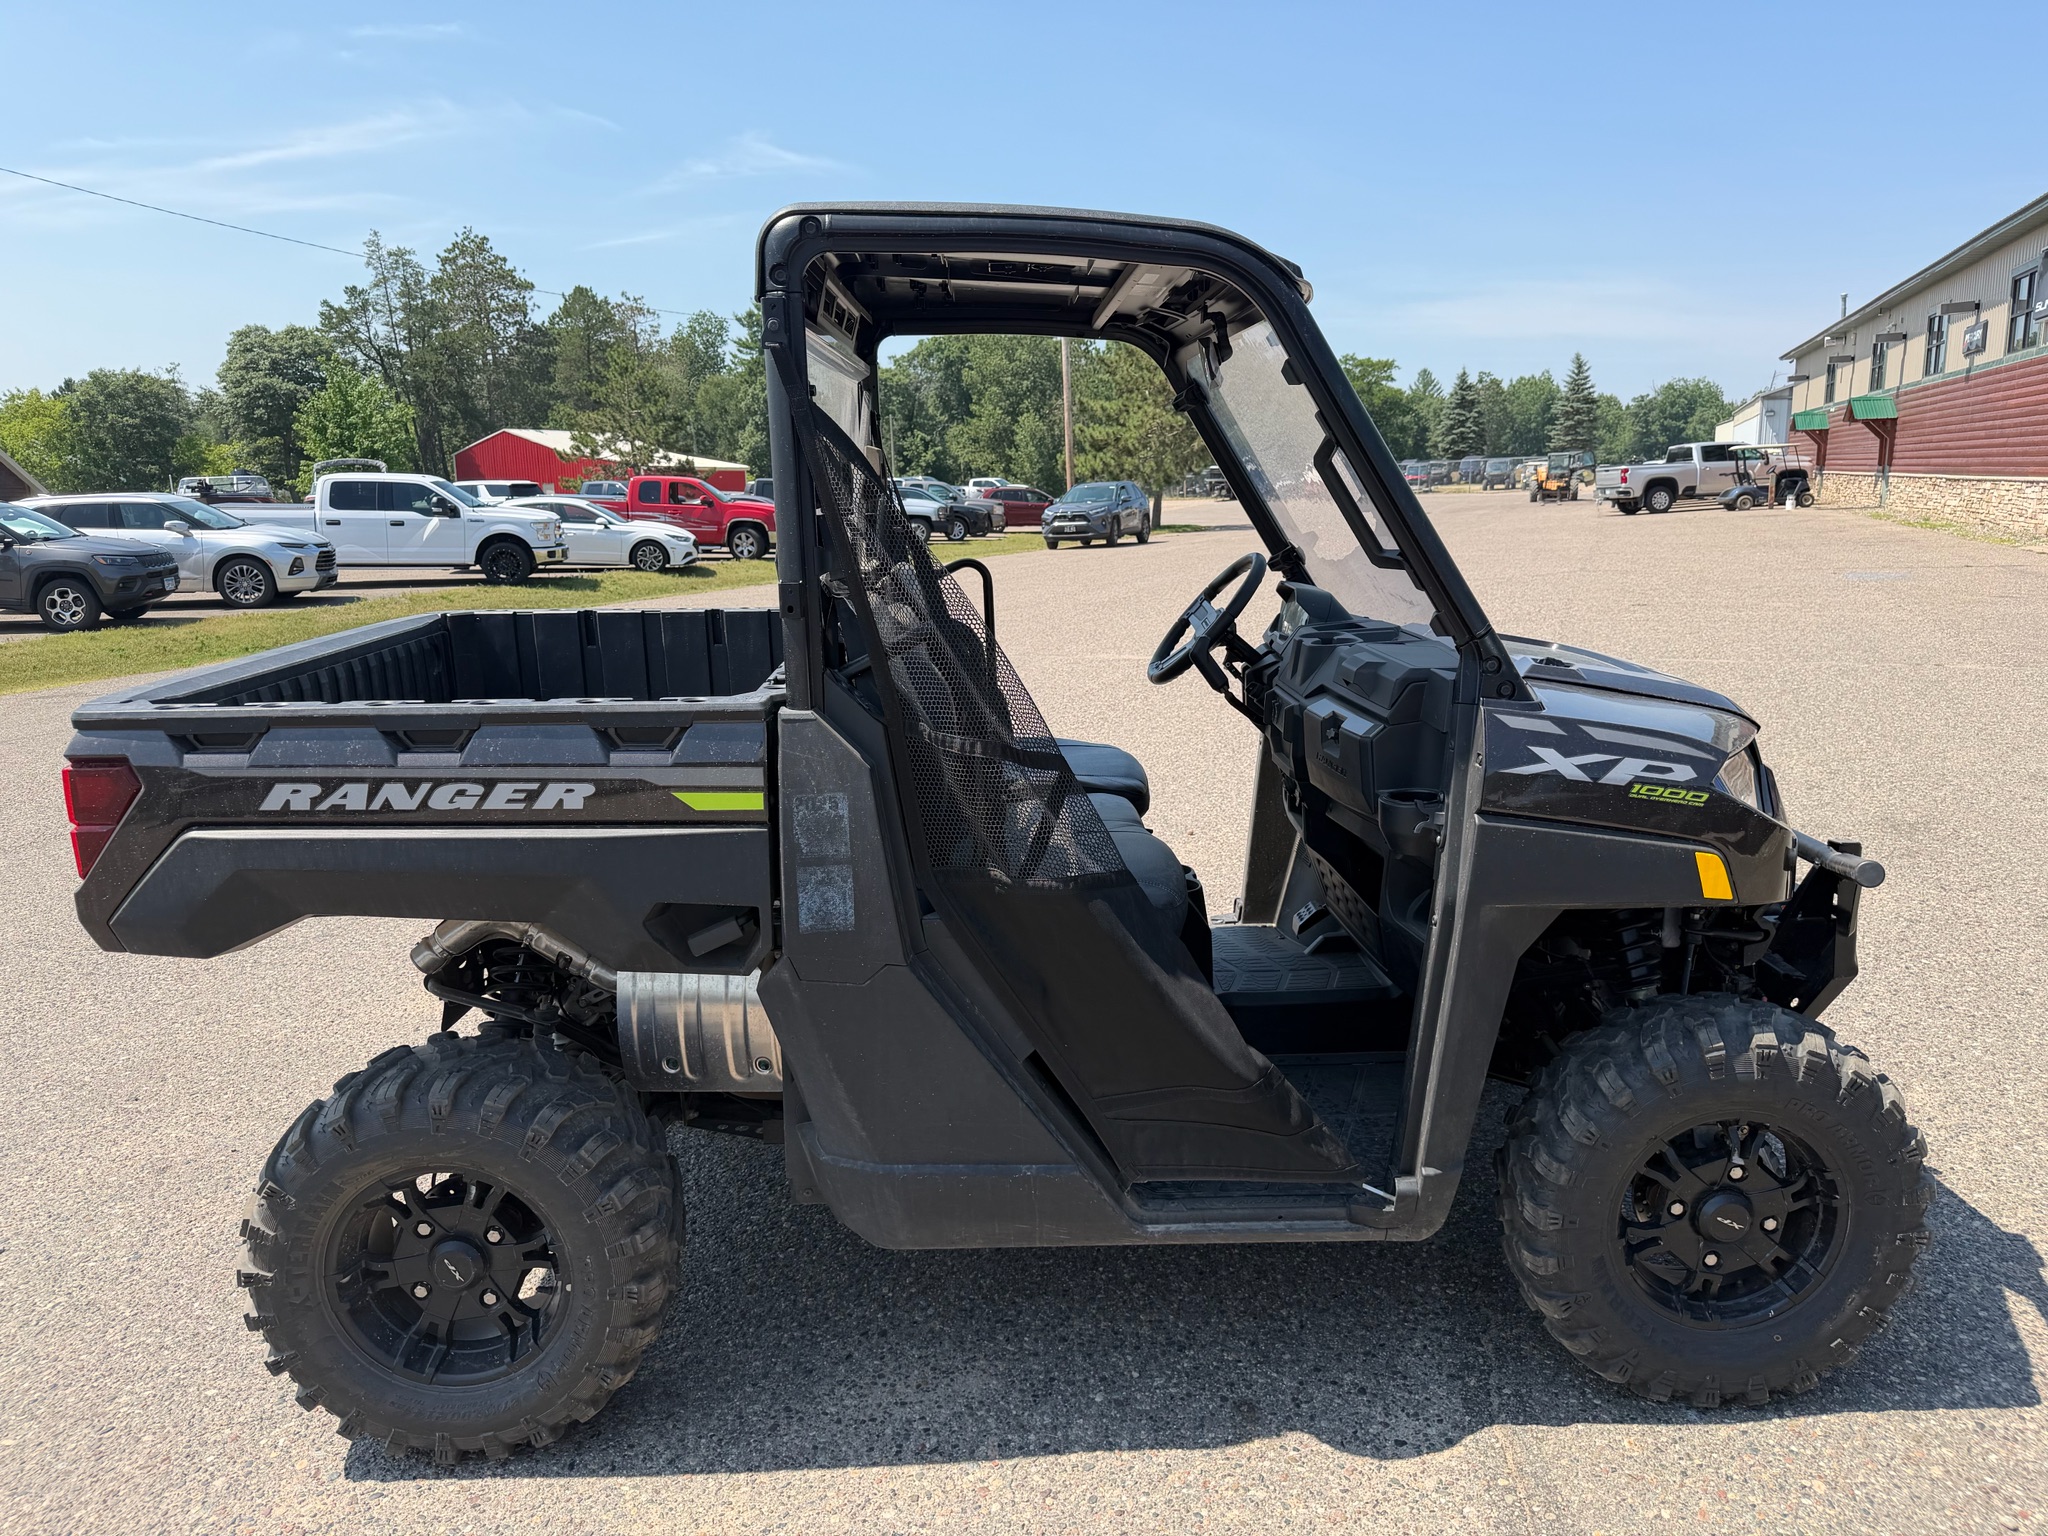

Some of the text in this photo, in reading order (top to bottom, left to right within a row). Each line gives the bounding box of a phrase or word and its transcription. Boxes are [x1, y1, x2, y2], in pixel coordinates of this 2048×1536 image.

[1499, 745, 1698, 786] XP
[258, 783, 596, 811] RANGER
[1630, 784, 1709, 802] 1000
[1650, 796, 1688, 805] OVERHEAD
[1784, 1096, 1882, 1188] PRO ARMOR
